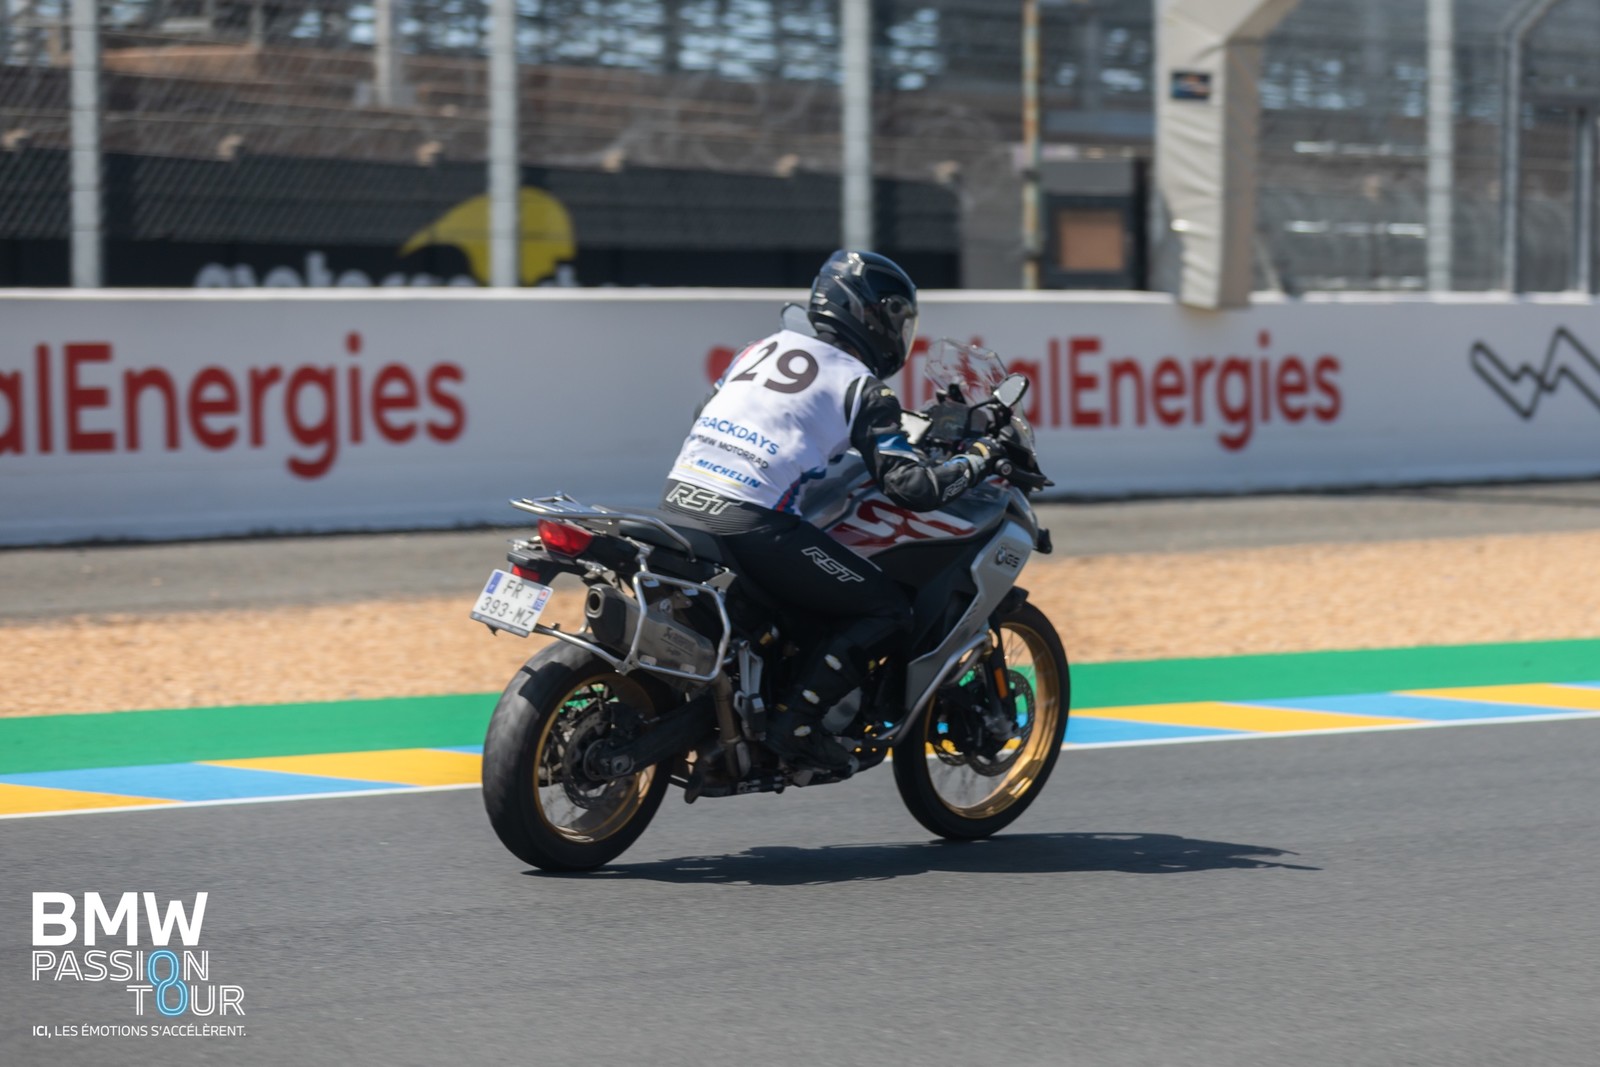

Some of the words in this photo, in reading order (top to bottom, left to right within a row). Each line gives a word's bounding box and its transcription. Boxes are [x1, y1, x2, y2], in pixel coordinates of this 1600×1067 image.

[729, 340, 819, 395] 29
[697, 416, 779, 456] RACKDAYS
[718, 441, 770, 470] MOTORRAD
[696, 458, 762, 489] MICHELIN
[666, 482, 745, 516] RST
[801, 546, 865, 583] RST
